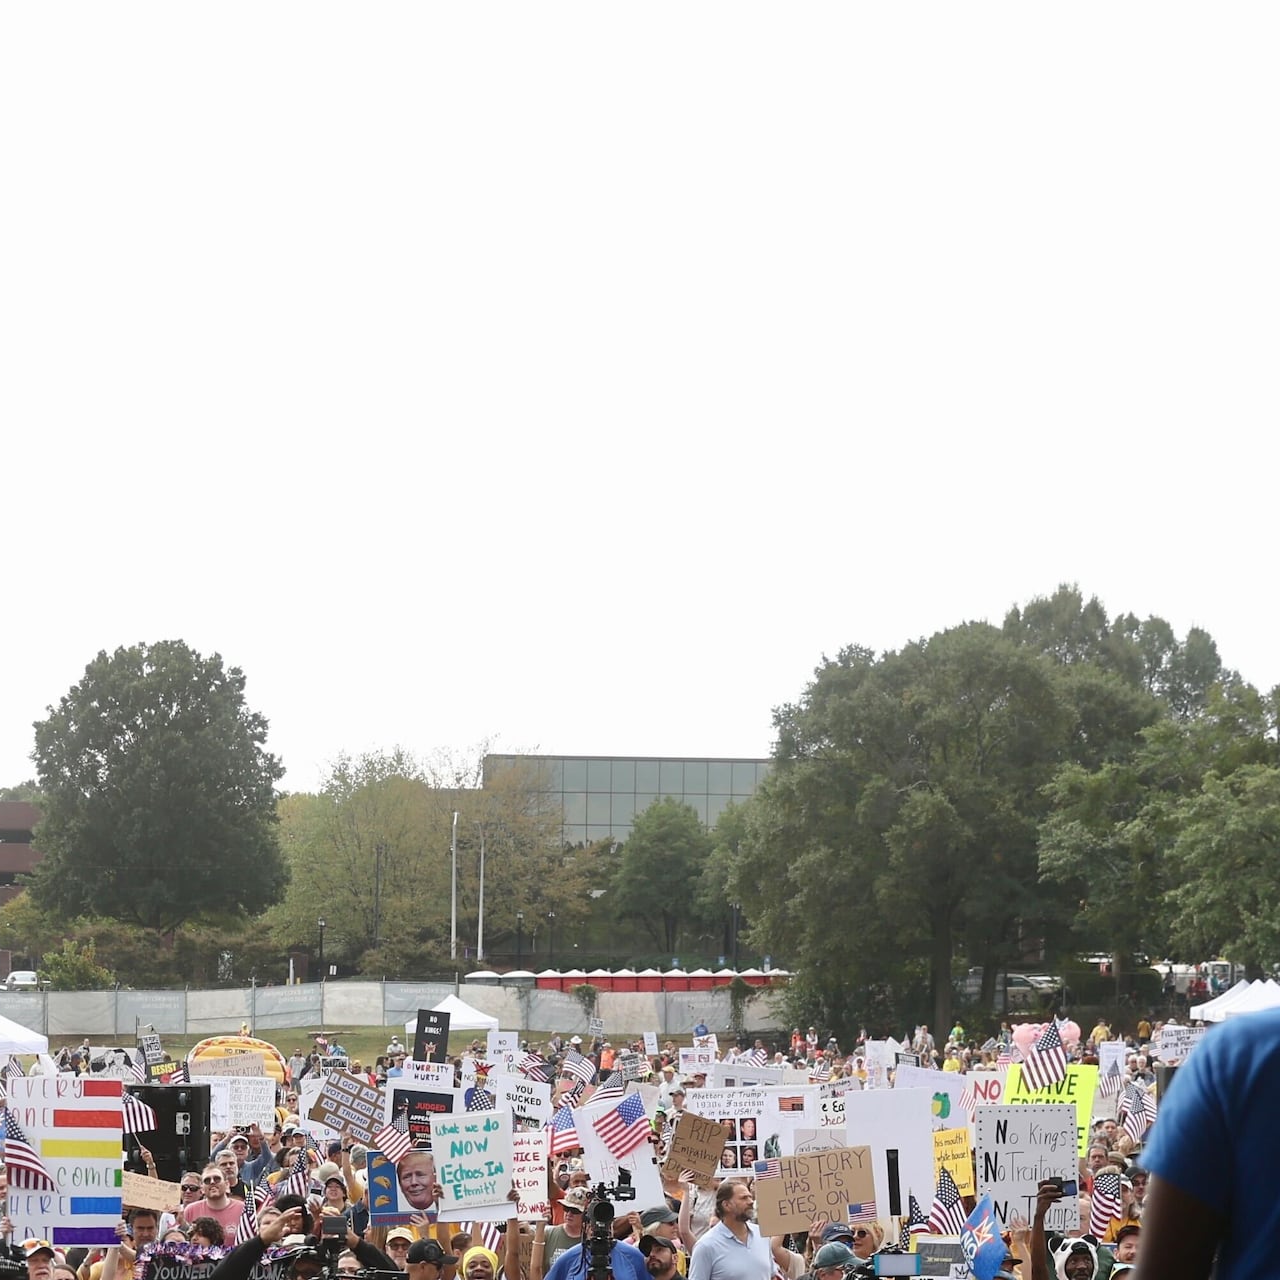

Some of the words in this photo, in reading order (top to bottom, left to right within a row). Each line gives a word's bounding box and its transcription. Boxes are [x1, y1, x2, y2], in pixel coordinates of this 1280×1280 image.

[151, 1062, 177, 1076] RESIST
[407, 1063, 449, 1073] DIVERSITY
[11, 1077, 84, 1099] EVERY
[342, 1080, 358, 1092] GOT
[363, 1090, 375, 1100] AS
[516, 1085, 533, 1095] YOU
[692, 1093, 724, 1101] Abettors
[739, 1090, 767, 1099] Trump's
[973, 1079, 1001, 1100] NO
[325, 1087, 350, 1103] VOTES
[356, 1101, 372, 1113] FOR
[415, 1102, 446, 1112] JUDGED
[506, 1093, 541, 1106] SUCKED
[517, 1105, 526, 1113] IN
[726, 1100, 764, 1108] Fascism
[324, 1100, 335, 1110] AS
[341, 1109, 368, 1127] TRUMP
[326, 1115, 342, 1127] FOR
[351, 1126, 370, 1140] KING
[435, 1123, 460, 1136] What
[465, 1124, 479, 1132] we
[483, 1118, 499, 1132] do
[689, 1119, 721, 1145] RIP
[996, 1119, 1018, 1145] No
[1029, 1122, 1068, 1152] Kings
[450, 1137, 488, 1158] NOW
[673, 1138, 719, 1166] Empathy
[441, 1164, 484, 1185] Echoes
[984, 1151, 1006, 1184] No
[1005, 1151, 1068, 1182] Traitors
[784, 1177, 810, 1195] HAS
[10, 1195, 66, 1216] HERE
[779, 1195, 817, 1217] EYES
[826, 1190, 849, 1206] ON
[994, 1200, 1020, 1226] No
[153, 1263, 179, 1280] YOU
